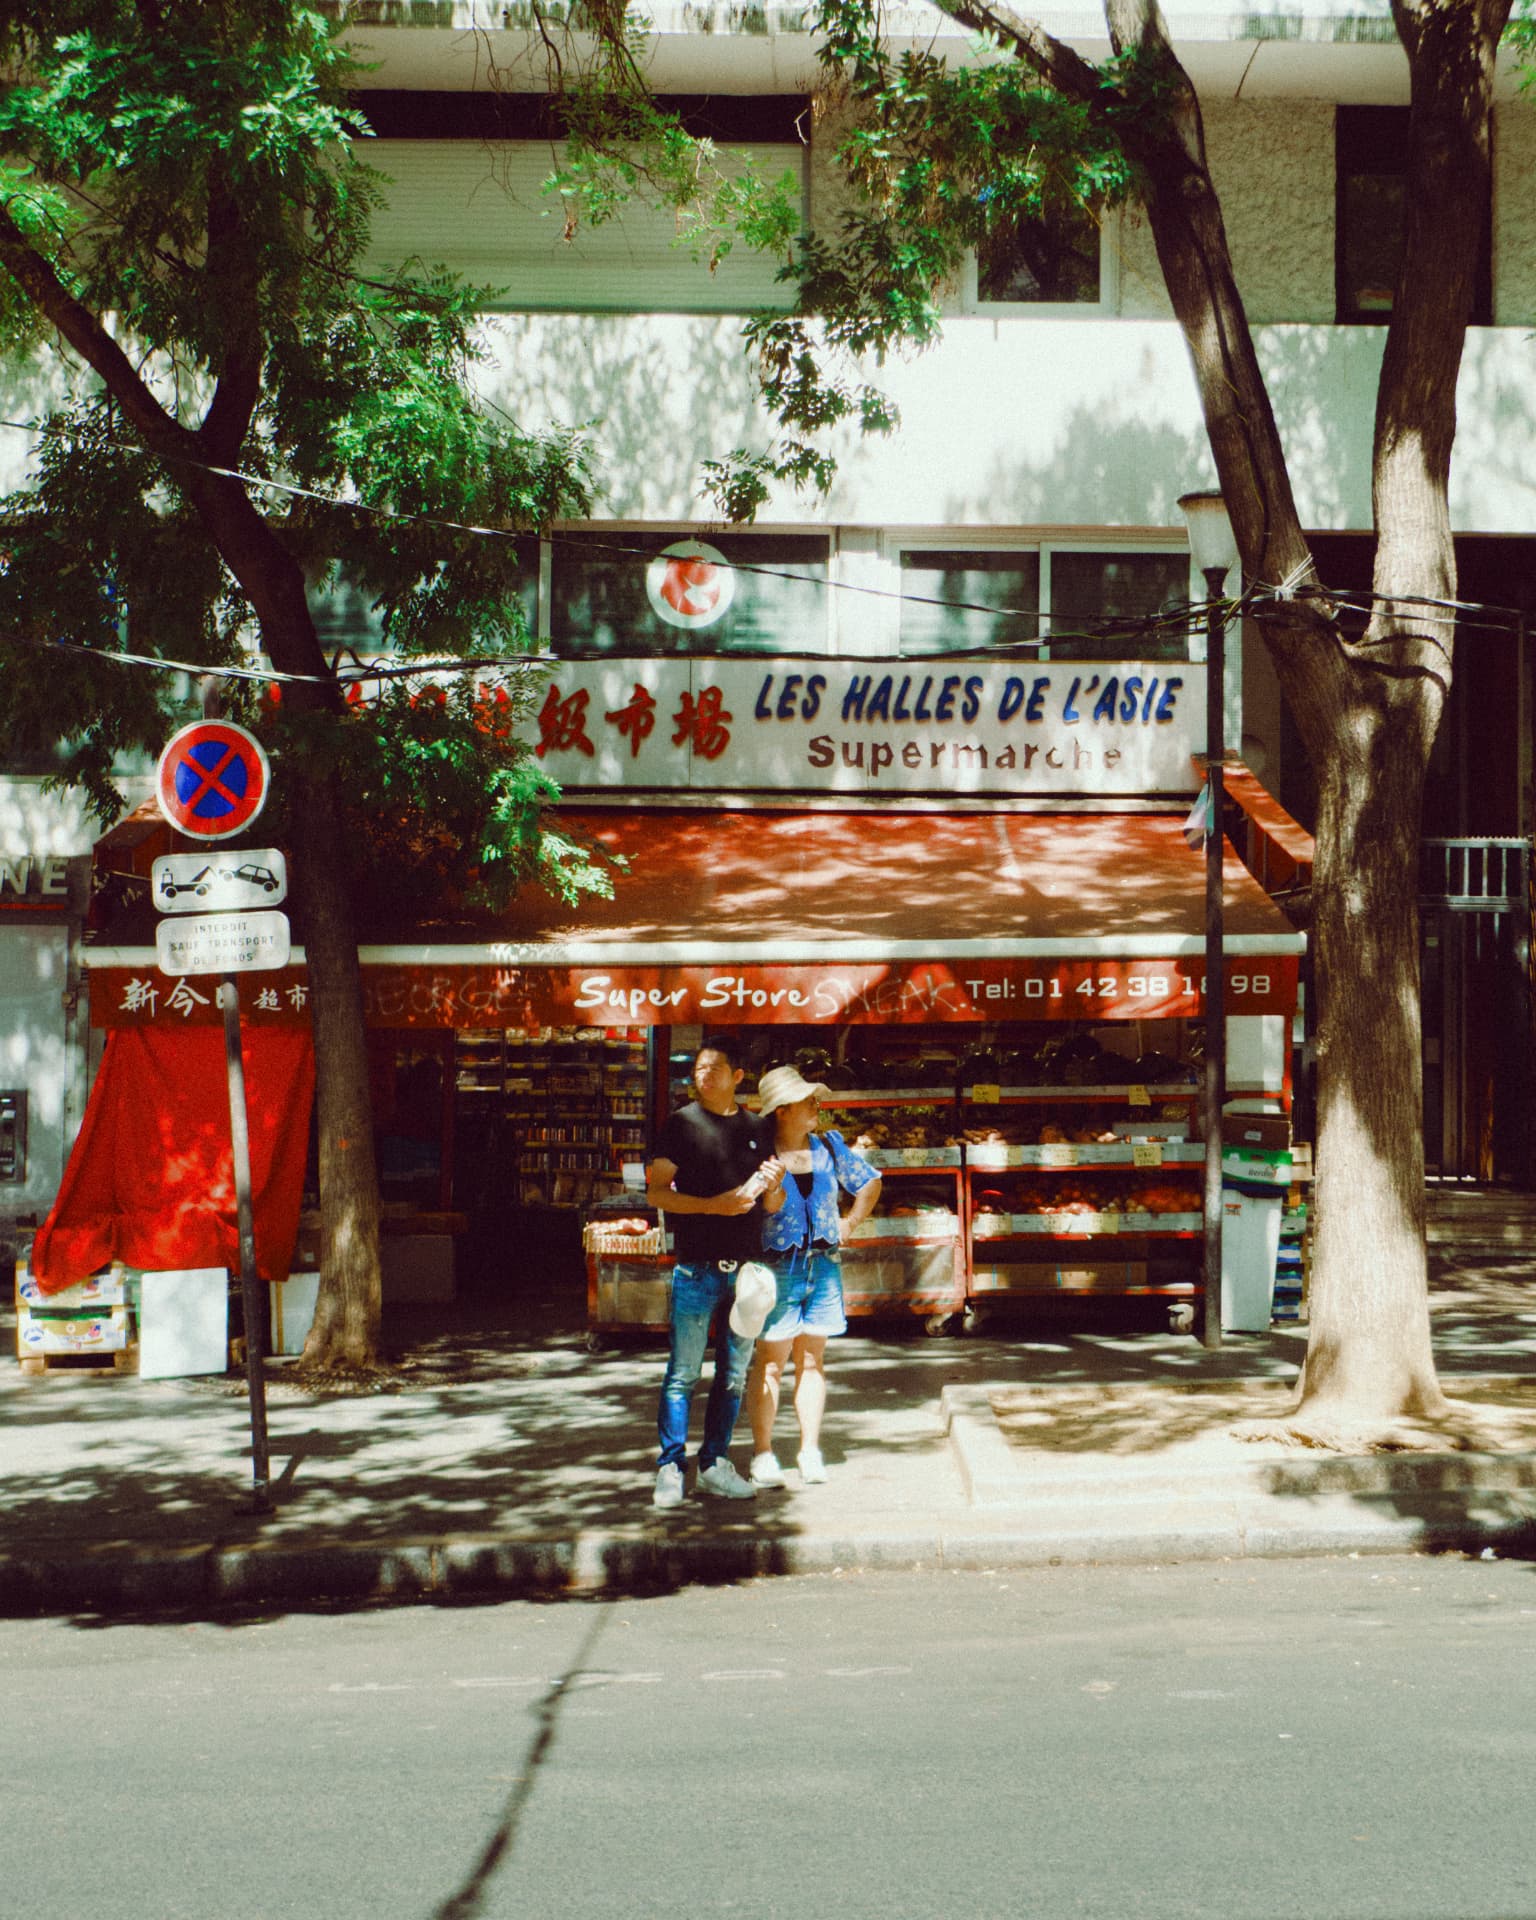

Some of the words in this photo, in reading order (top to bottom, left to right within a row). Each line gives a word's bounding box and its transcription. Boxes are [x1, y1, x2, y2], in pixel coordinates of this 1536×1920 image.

[755, 674, 827, 722] LES
[841, 674, 984, 723] HALLES
[998, 676, 1051, 722] DE
[1062, 676, 1184, 725] L'ASIE
[194, 922, 248, 933] INTERDIT
[208, 936, 274, 949] TRANSPORT
[575, 975, 688, 1018] Super
[700, 976, 811, 1008] Store
[966, 978, 1016, 999] Tel:
[1025, 978, 1063, 998] 01
[1076, 976, 1118, 997] 42
[1127, 976, 1169, 997] 38
[1231, 975, 1271, 994] 98
